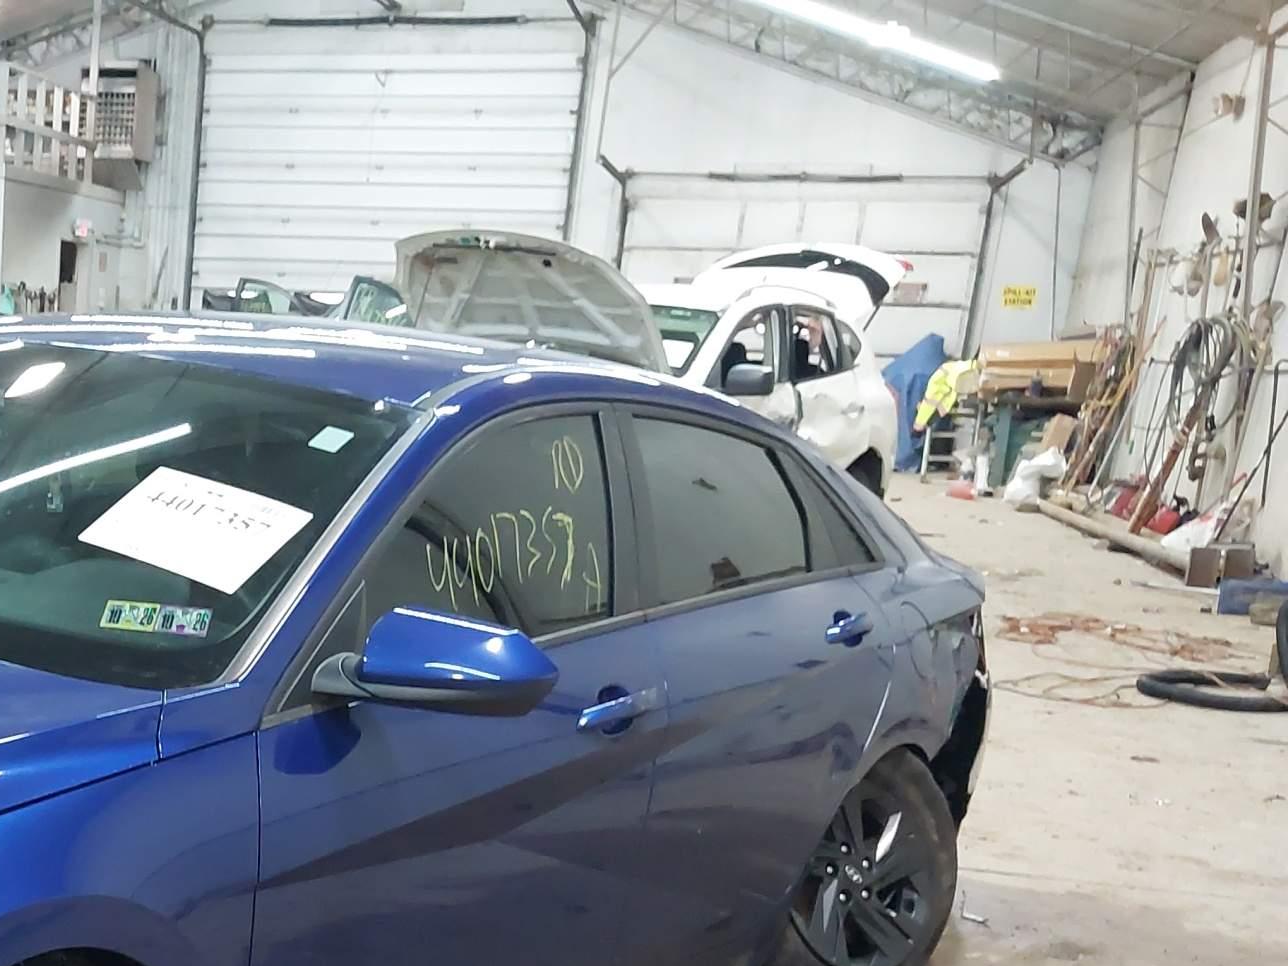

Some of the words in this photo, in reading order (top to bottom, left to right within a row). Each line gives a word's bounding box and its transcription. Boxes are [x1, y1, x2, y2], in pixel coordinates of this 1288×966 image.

[107, 607, 123, 625] 10
[139, 606, 154, 626] 26
[160, 612, 175, 630] 10
[192, 611, 209, 632] 26
